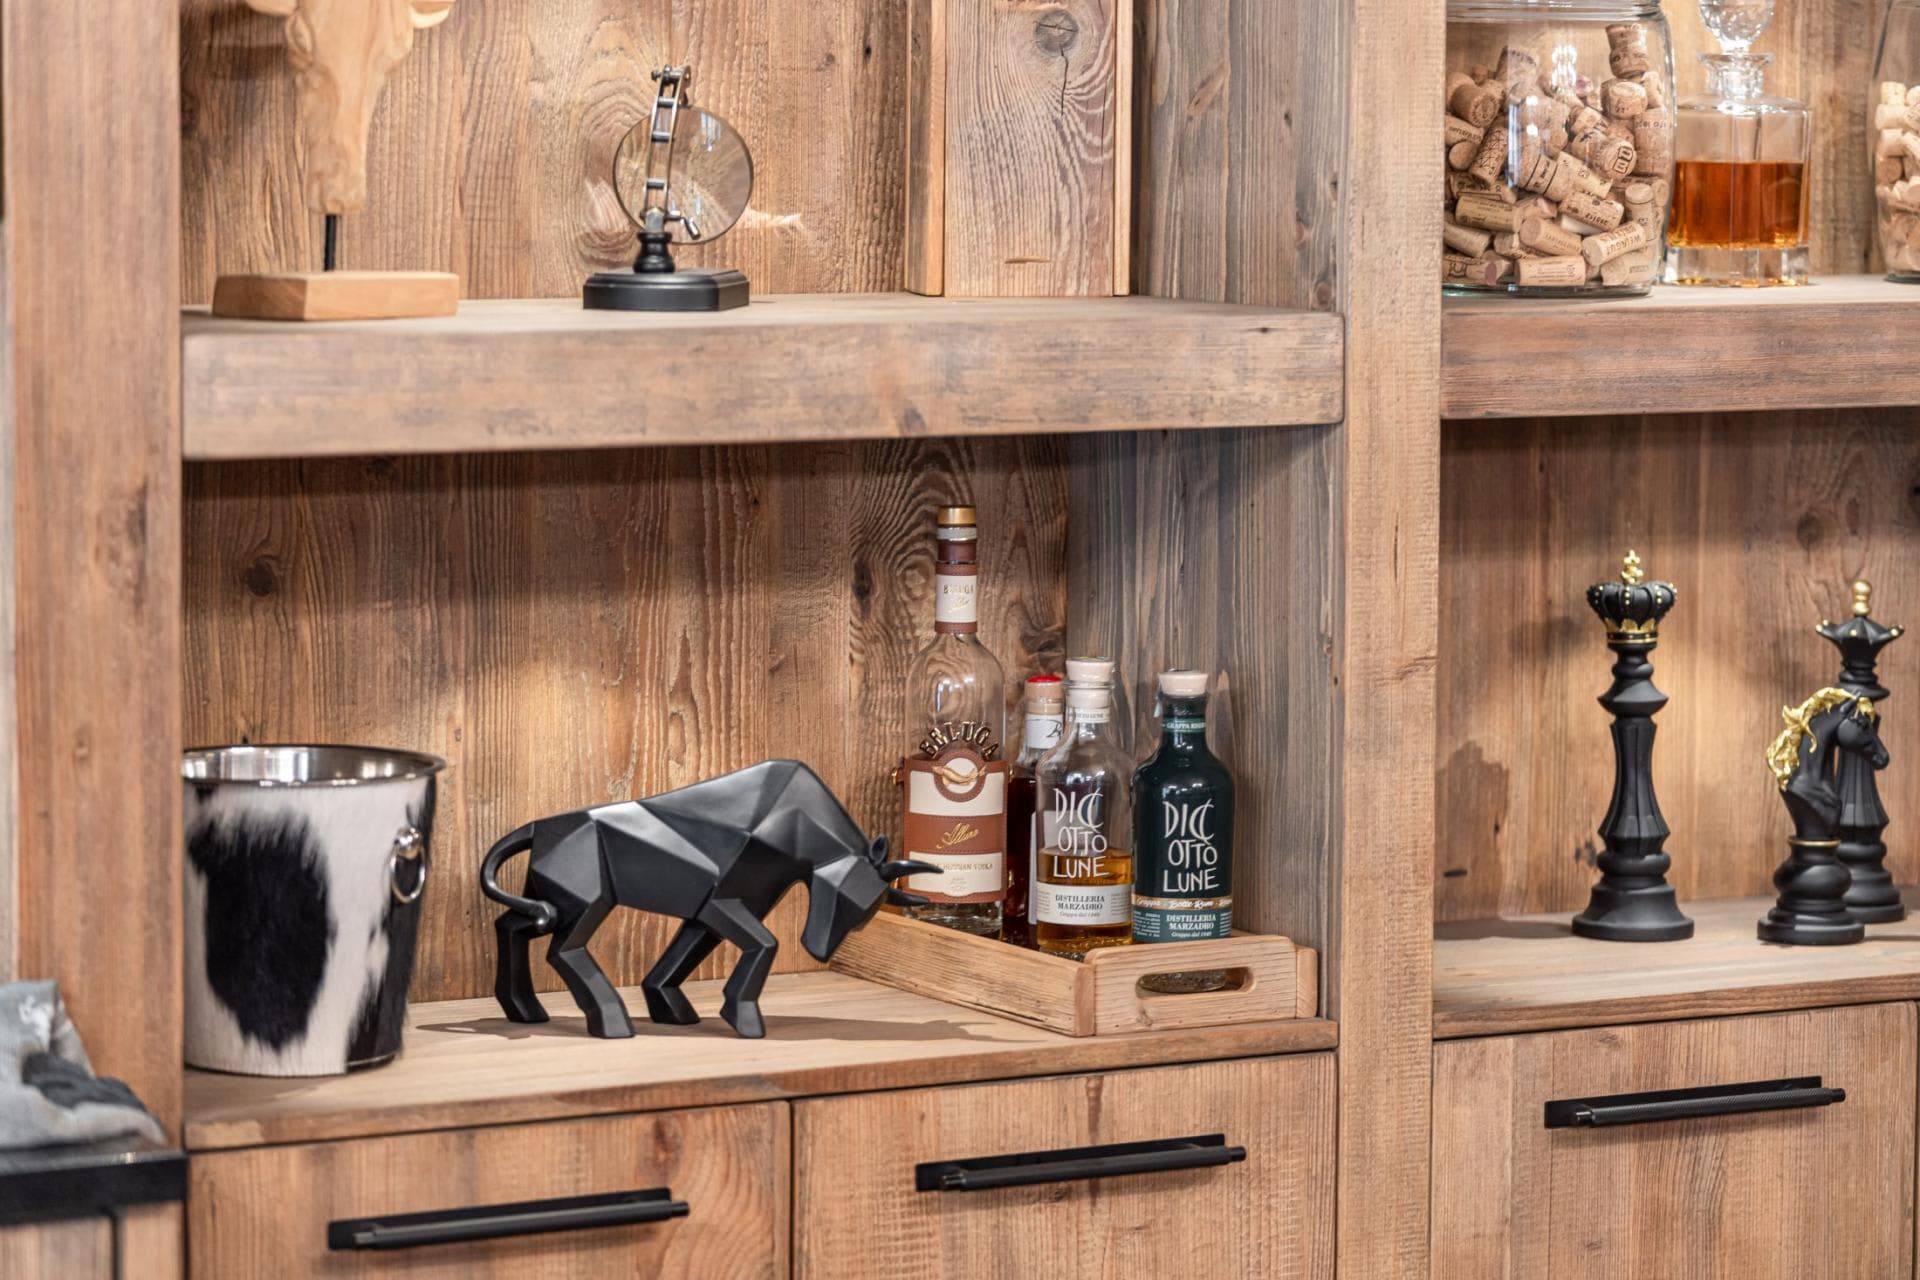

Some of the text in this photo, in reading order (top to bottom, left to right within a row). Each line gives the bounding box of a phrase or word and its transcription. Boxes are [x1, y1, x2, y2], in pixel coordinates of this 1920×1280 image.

[919, 720, 1000, 760] BELUGA
[1057, 826, 1108, 856] OTTO
[1168, 839, 1218, 870] OTTO
[1053, 855, 1110, 879] LUNE
[1163, 867, 1220, 893] LUNE
[1055, 894, 1105, 902] DISTILLERIA
[1057, 902, 1103, 911] MARZADRO
[1166, 914, 1217, 922] DISTILLERIA
[1168, 922, 1214, 931] MARZADRO
